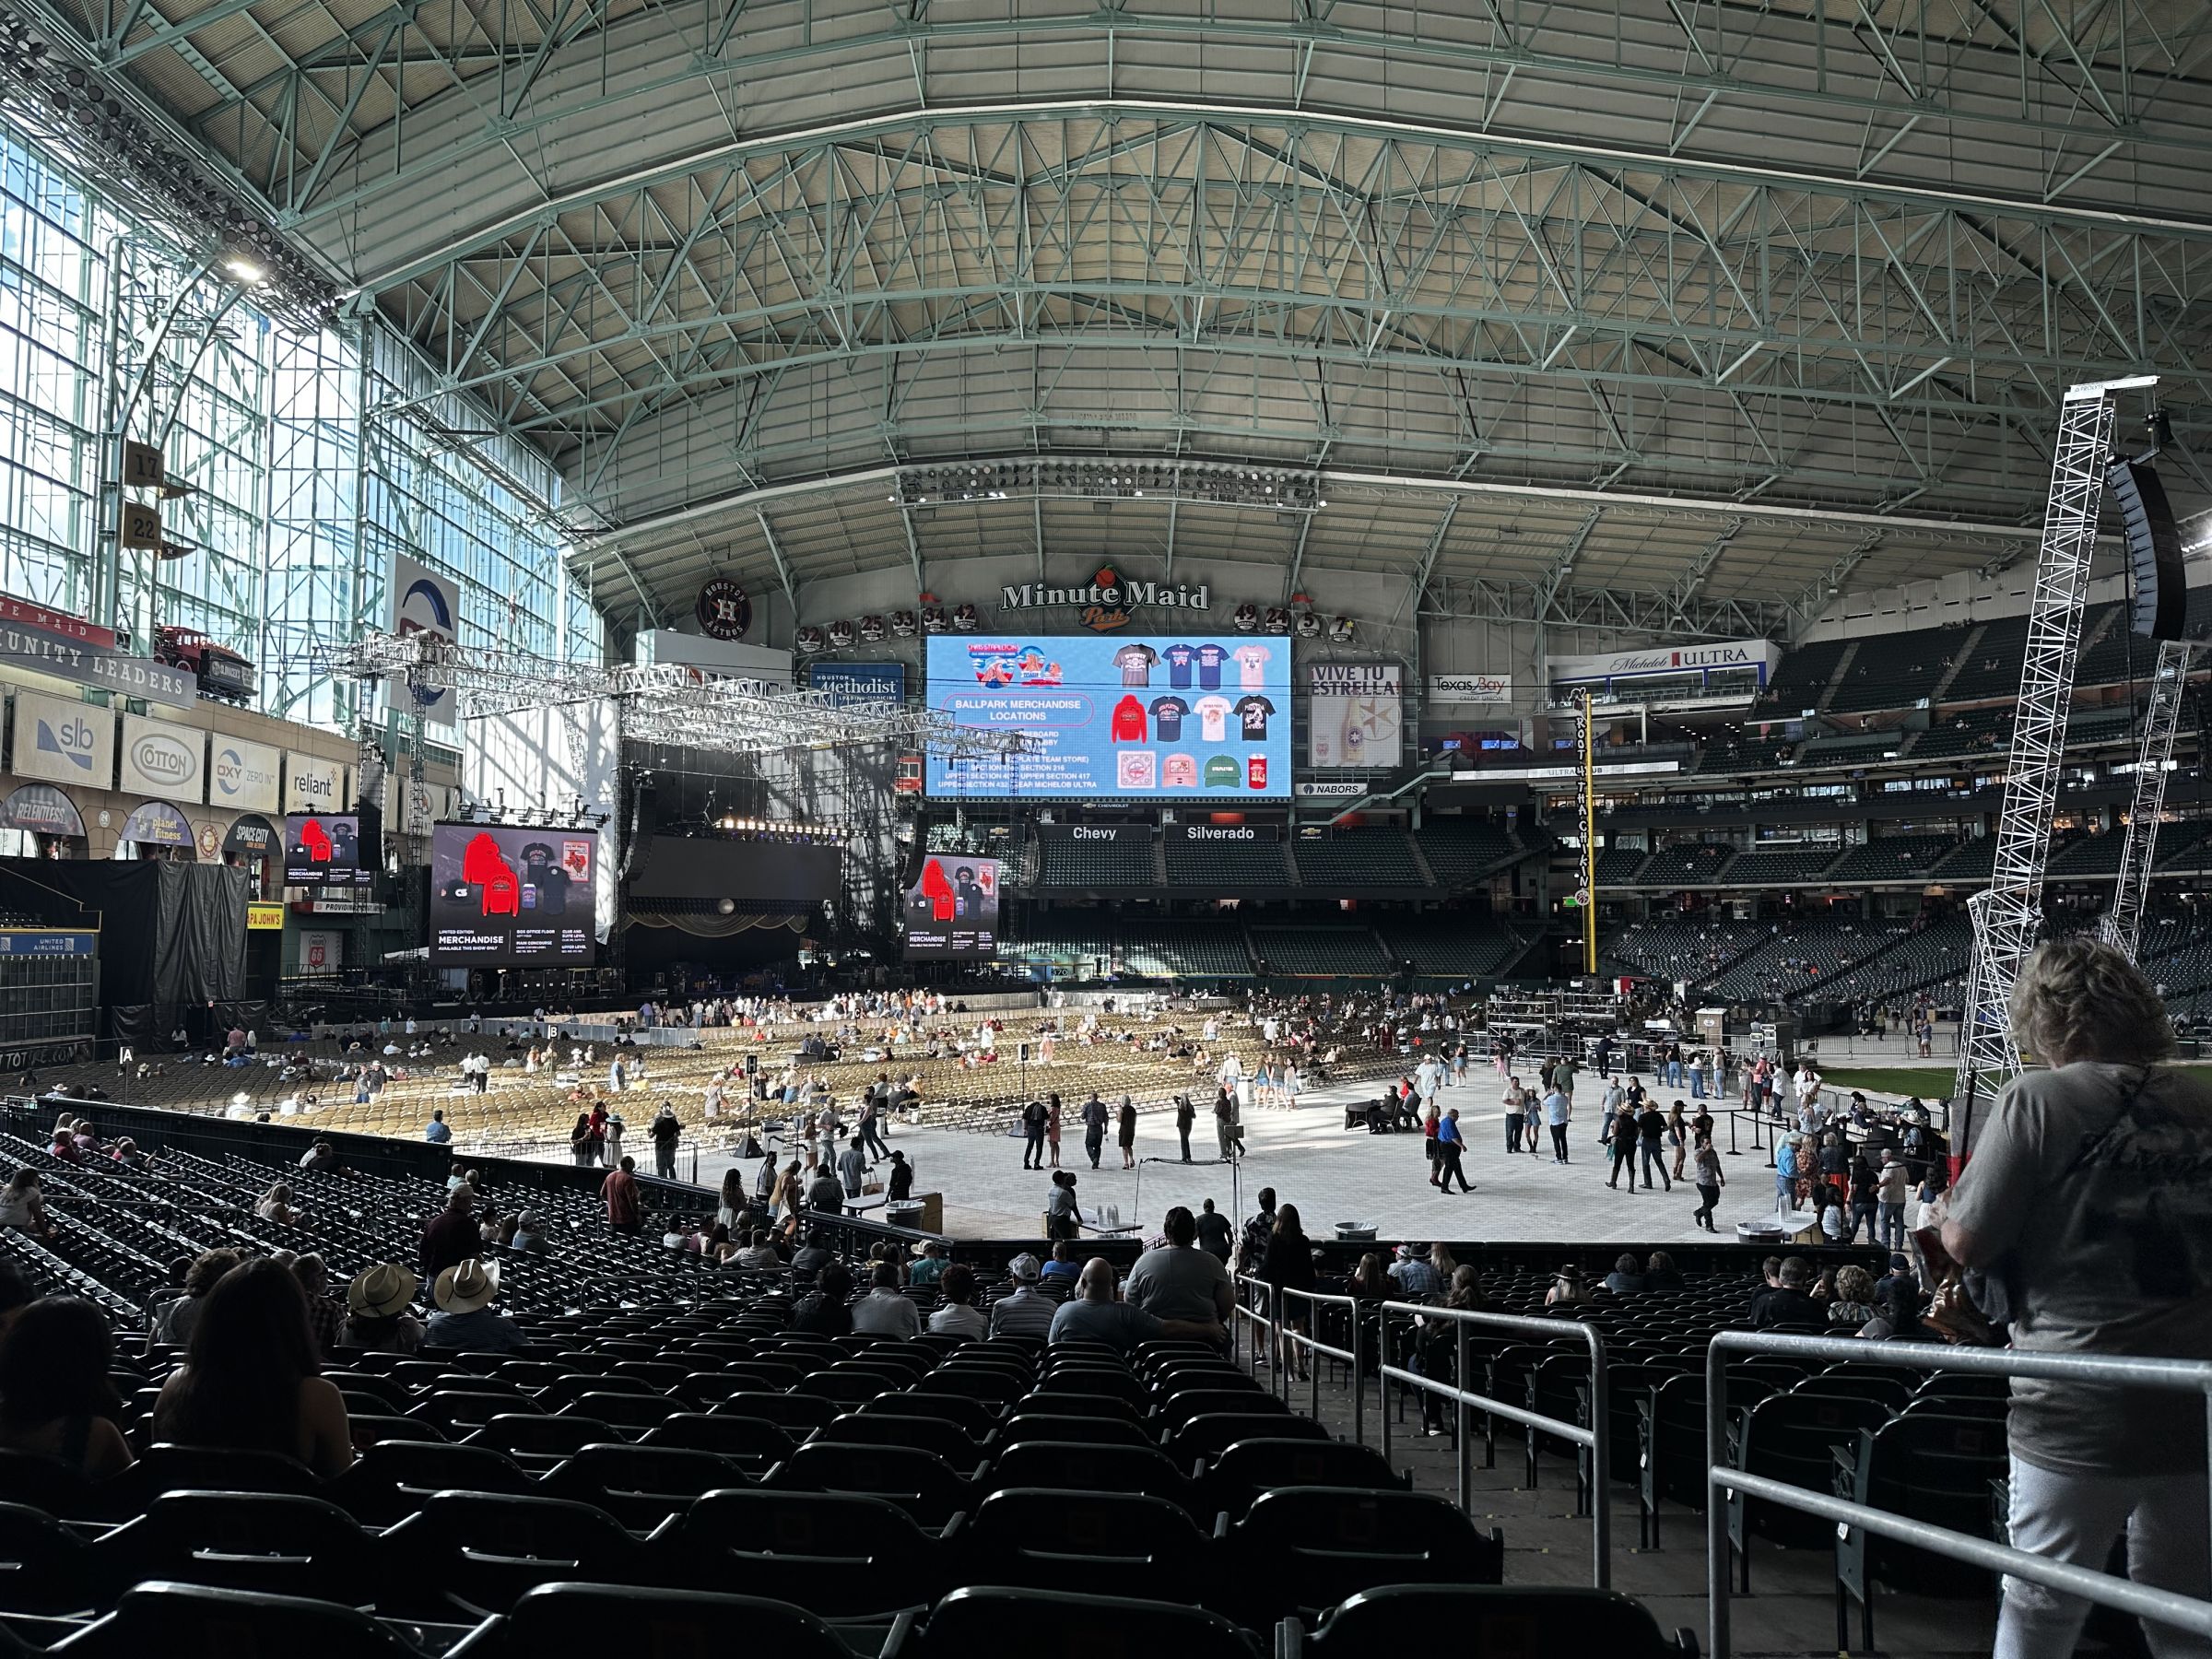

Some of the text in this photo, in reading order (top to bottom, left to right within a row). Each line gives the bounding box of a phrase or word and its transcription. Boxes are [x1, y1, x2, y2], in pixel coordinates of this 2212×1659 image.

[135, 454, 158, 477] 17
[134, 518, 155, 539] 22
[705, 582, 746, 602] HOUSTON
[1001, 581, 1209, 609] Minute Maid
[718, 599, 736, 621] H
[924, 607, 946, 622] 34
[954, 605, 975, 619] 42
[1081, 606, 1130, 628] Park
[1235, 605, 1255, 619] 49
[1266, 608, 1289, 623] 24
[38, 613, 87, 636] MAID
[862, 615, 882, 631] 25
[893, 611, 913, 627] 33
[1303, 612, 1314, 627] 5
[1335, 617, 1347, 632] 7
[707, 620, 743, 636] ASTROS
[799, 626, 820, 641] 32
[830, 621, 851, 636] 40
[0, 629, 82, 667] UNITY
[92, 655, 182, 695] LEADERS
[1610, 648, 1748, 671] Michelob ULTRA
[1363, 666, 1383, 680] TU
[820, 678, 897, 693] Methodist
[1434, 677, 1505, 695] Texas Bay
[956, 700, 1080, 709] BALLPARK MERCHANDISE
[60, 717, 94, 749] slb
[1576, 717, 1586, 759] ROOT
[140, 744, 187, 776] COTTON
[217, 765, 242, 780] OXY
[246, 770, 264, 783] ZERO
[1576, 766, 1585, 777] 4
[294, 772, 332, 796] reliant
[1317, 785, 1359, 794] NABORS
[1577, 782, 1587, 816] THA
[17, 802, 66, 824] RELENTLESS
[152, 817, 177, 829] planet
[155, 827, 182, 841] fitness
[236, 825, 269, 843] SPACE CITY
[1074, 827, 1254, 840] Chevy Silverado
[1578, 820, 1588, 887] CHIKIN
[259, 913, 279, 925] JOHN'S
[439, 935, 503, 944] MERCHANDISE
[312, 948, 323, 961] 66
[550, 1026, 558, 1038] B
[123, 1048, 133, 1062] A
[747, 1057, 756, 1072] H
